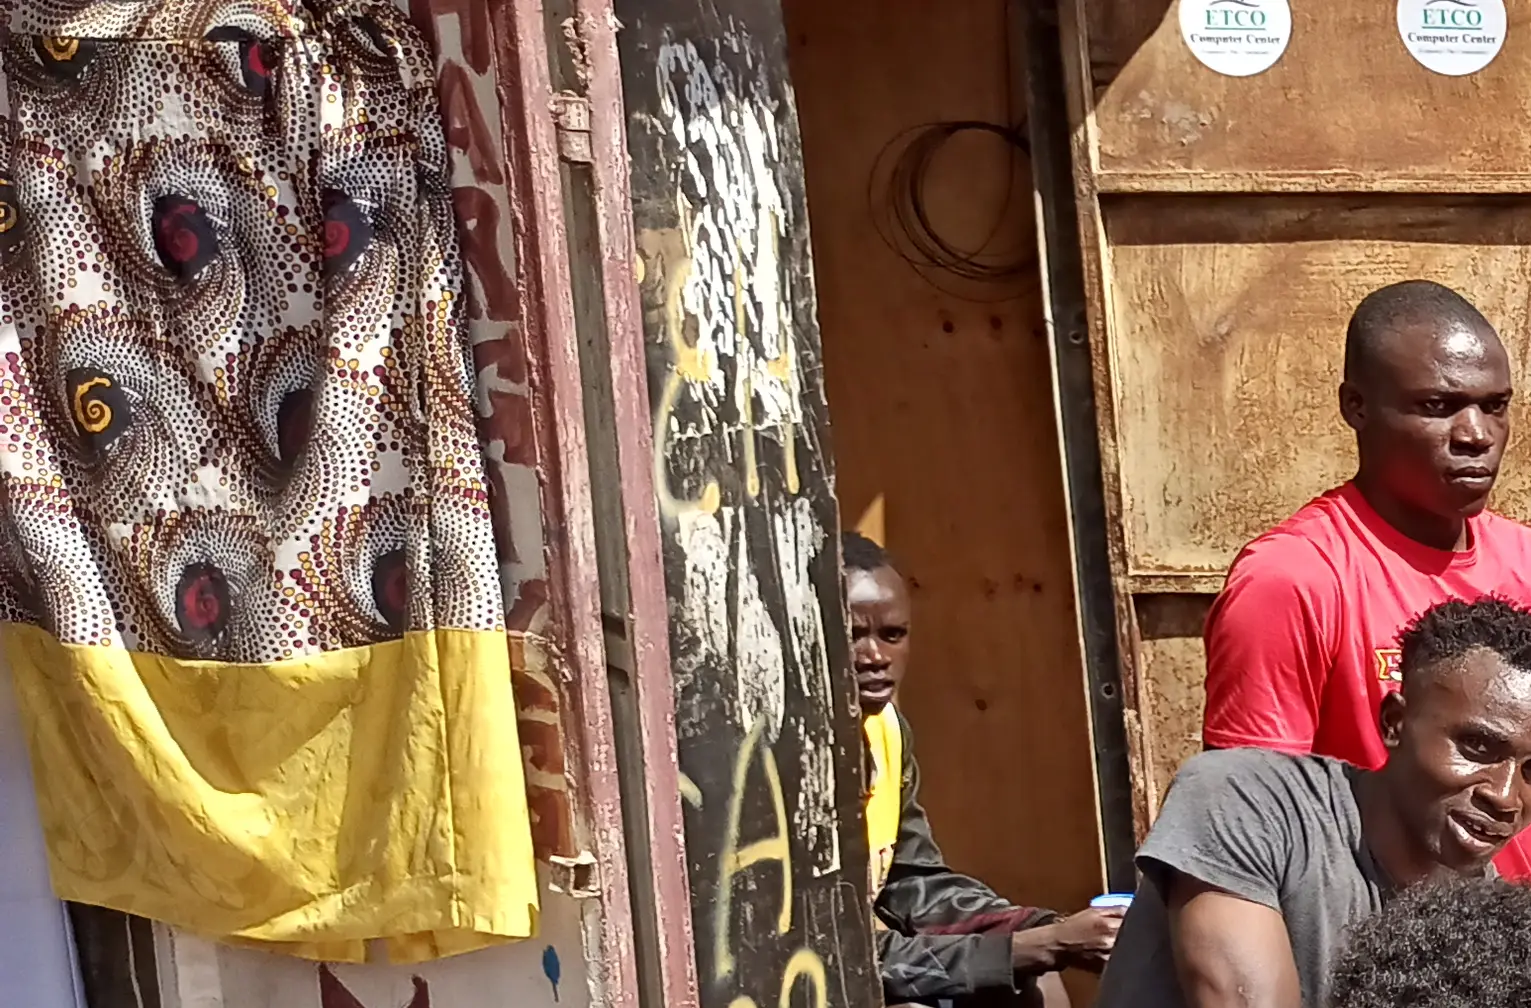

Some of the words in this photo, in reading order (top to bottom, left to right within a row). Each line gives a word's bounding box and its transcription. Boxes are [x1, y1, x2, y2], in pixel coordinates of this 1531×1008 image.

[1206, 9, 1266, 26] ETCO
[1423, 9, 1482, 26] ETCO
[1190, 33, 1242, 45] Computer
[1246, 34, 1280, 44] Center
[1408, 32, 1458, 45] Computer
[1462, 34, 1496, 44] Center
